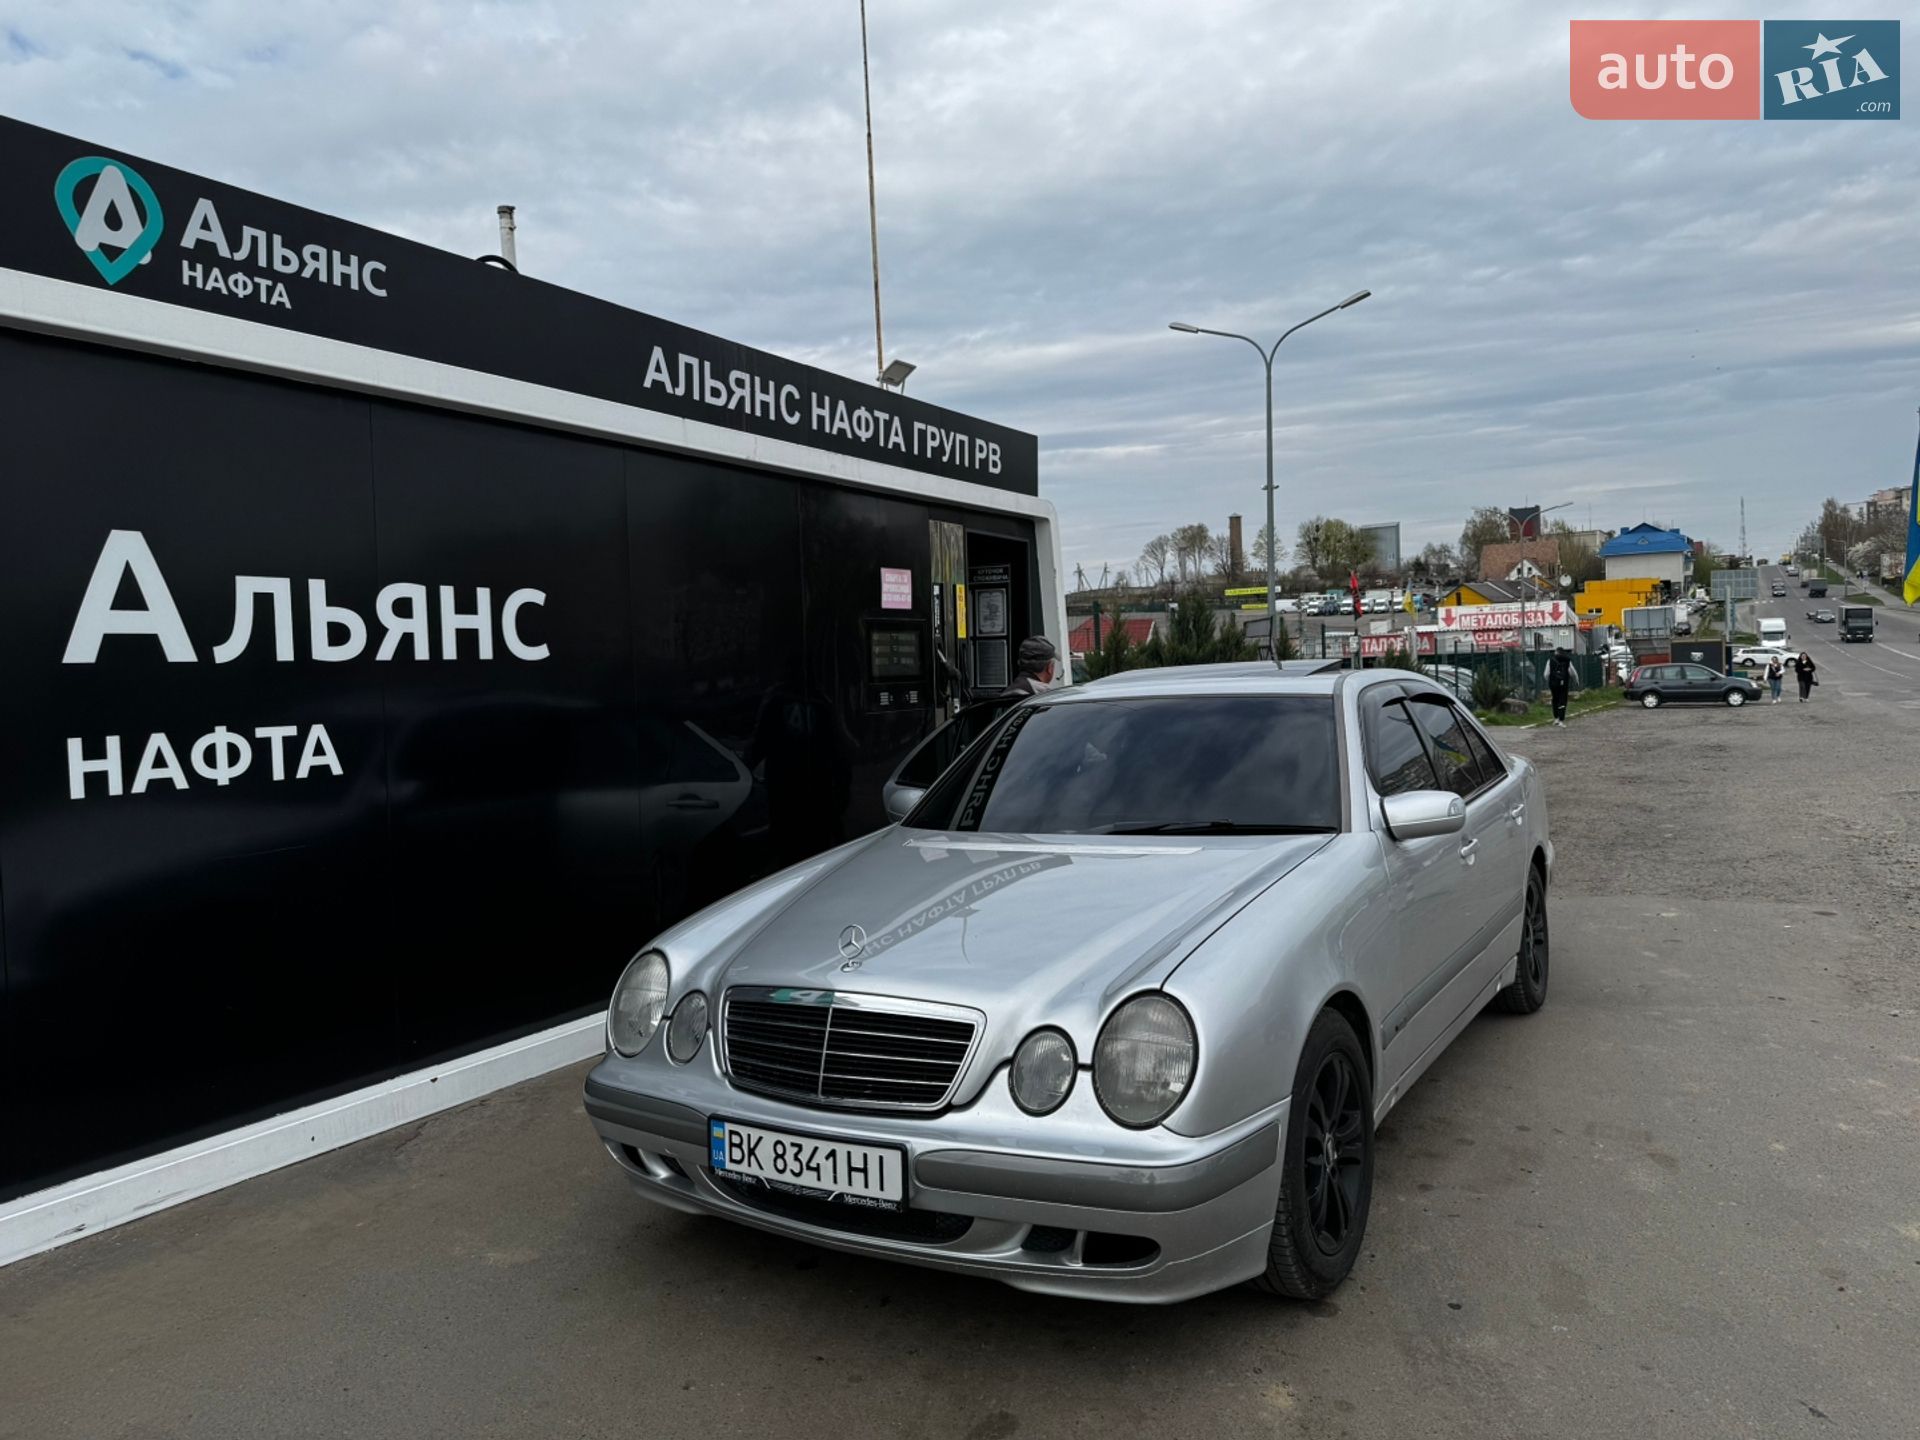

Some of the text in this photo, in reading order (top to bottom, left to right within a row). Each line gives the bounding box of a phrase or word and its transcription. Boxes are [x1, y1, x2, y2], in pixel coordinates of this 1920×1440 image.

[181, 260, 292, 309] НАФТА
[643, 345, 1002, 475] АЛЬЯНС НАФТА ГРУП РВ
[66, 723, 344, 800] НАФТА
[713, 1150, 725, 1162] UA
[714, 1167, 757, 1185] Mercedes-Benz
[728, 1129, 764, 1171] BK
[773, 1139, 838, 1185] 8341
[843, 1194, 898, 1211] Mercedes-Benz
